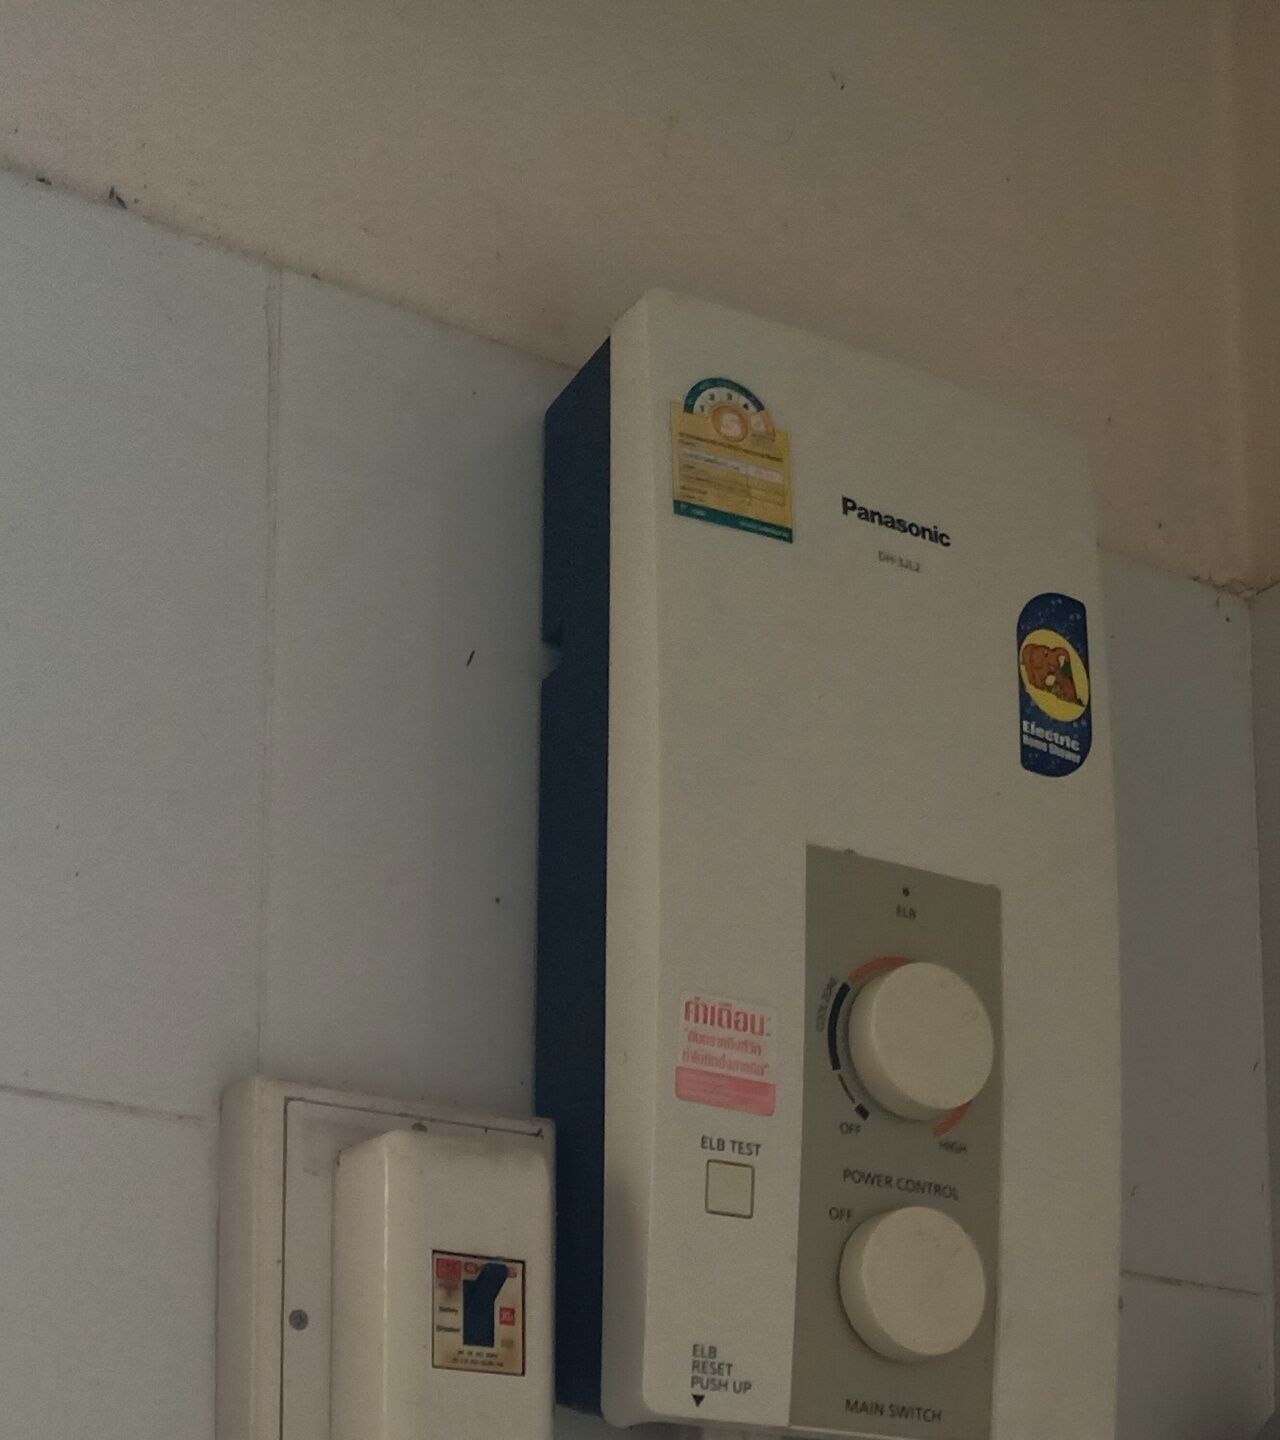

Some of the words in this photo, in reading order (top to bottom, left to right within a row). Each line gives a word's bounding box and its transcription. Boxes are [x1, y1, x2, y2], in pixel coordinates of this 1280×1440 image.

[841, 496, 951, 547] Panasonic
[1022, 720, 1080, 751] Electric
[839, 1122, 861, 1135] OFF
[701, 1134, 726, 1152] ELB
[730, 1140, 761, 1157] TEST
[842, 1168, 893, 1190] POWER
[896, 1176, 959, 1201] CONTROL
[829, 1207, 853, 1221] OFF
[692, 1343, 717, 1359] ELB
[691, 1359, 733, 1376] RESET
[690, 1375, 728, 1392] PUSH
[733, 1380, 752, 1394] UP
[845, 1398, 885, 1417] MAIN
[889, 1403, 943, 1423] SWITCH
